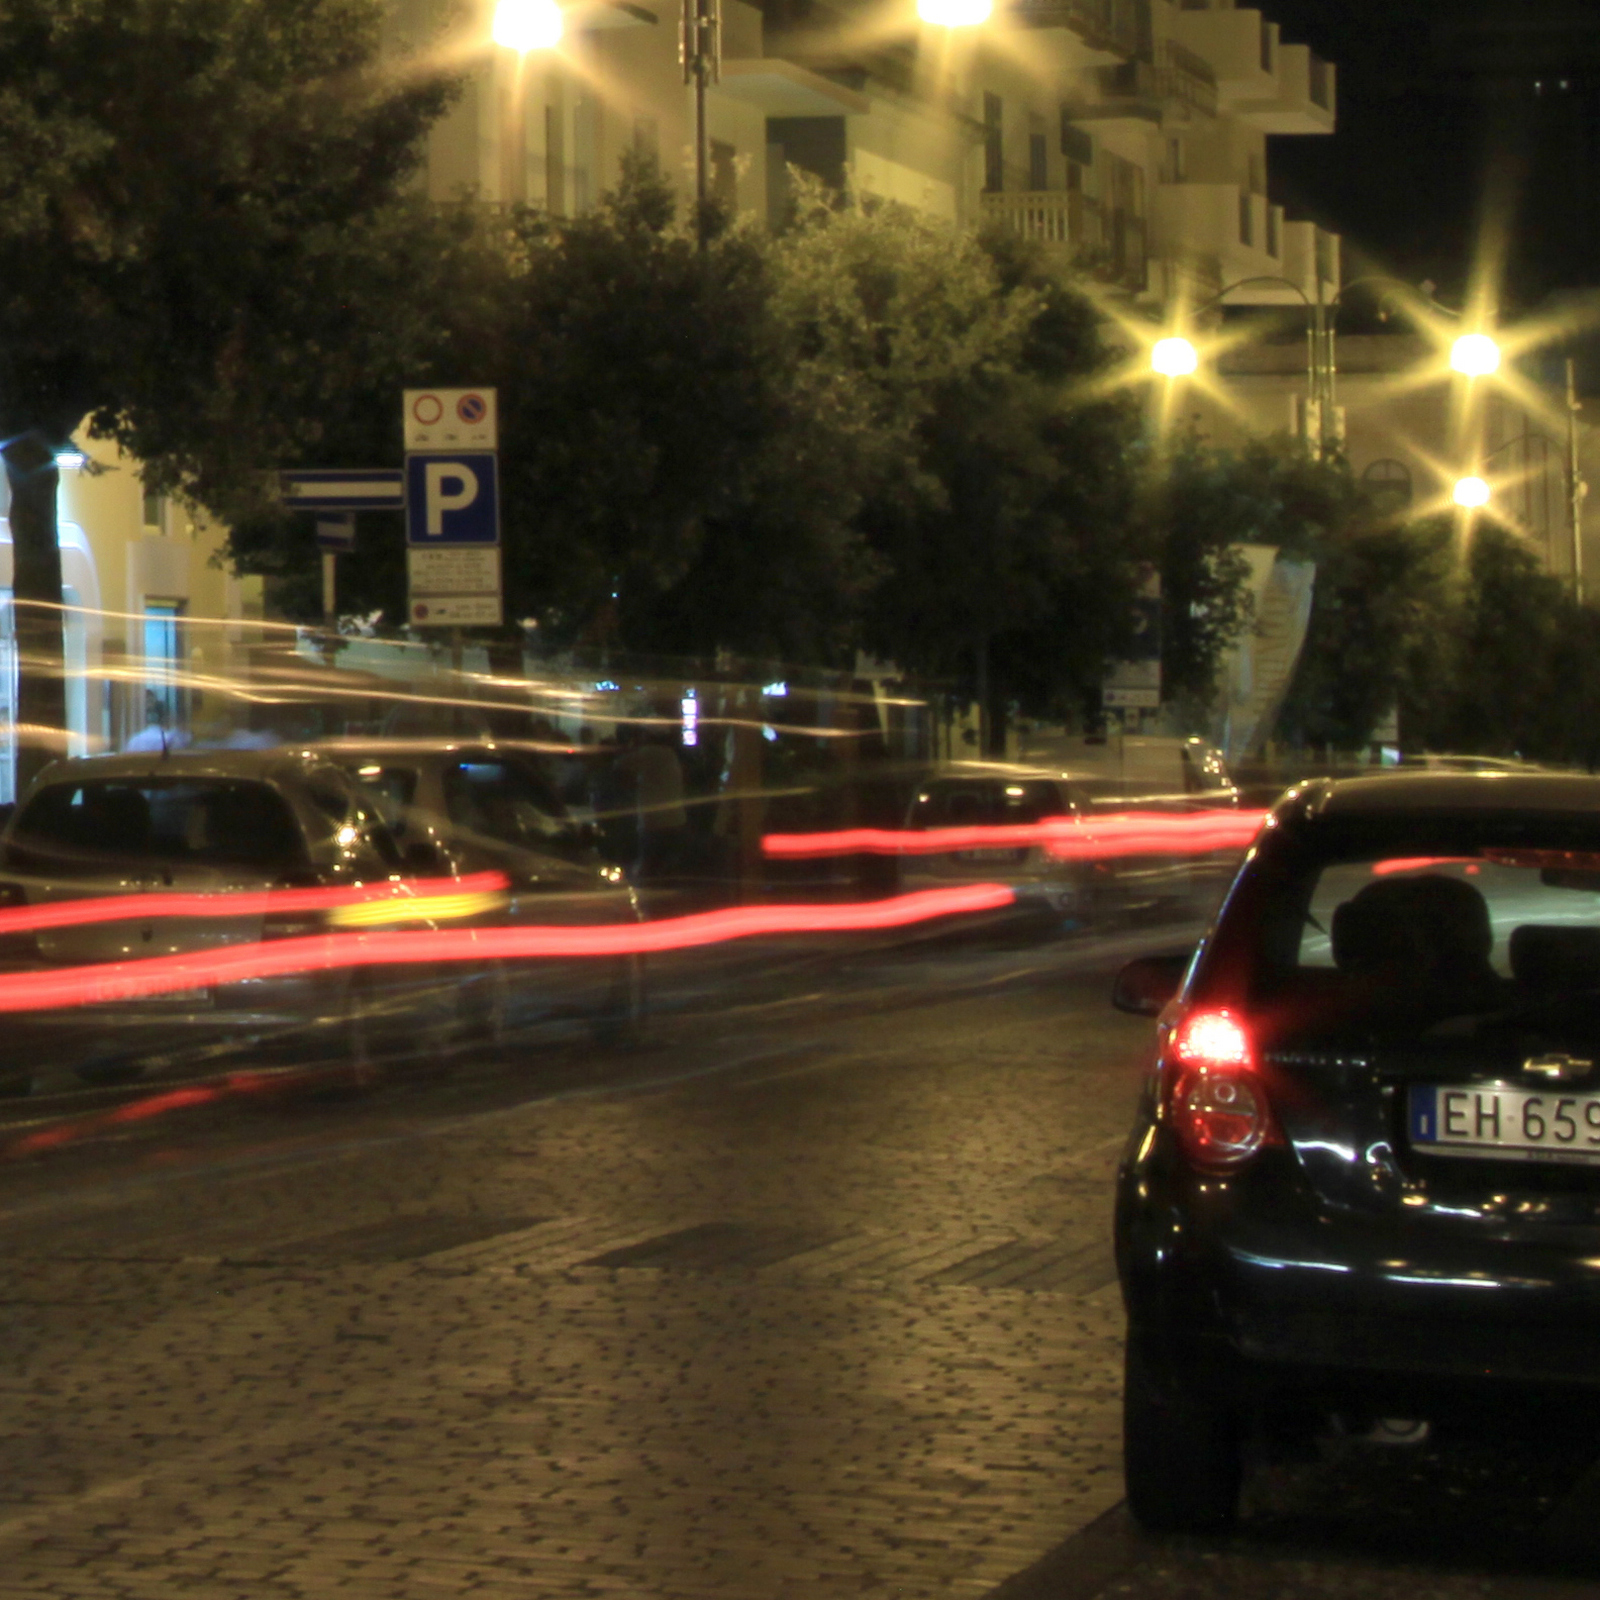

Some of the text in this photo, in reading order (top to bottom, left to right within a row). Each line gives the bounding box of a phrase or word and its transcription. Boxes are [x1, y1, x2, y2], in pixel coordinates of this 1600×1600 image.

[425, 462, 479, 536] P
[1443, 1091, 1600, 1144] EH 659
